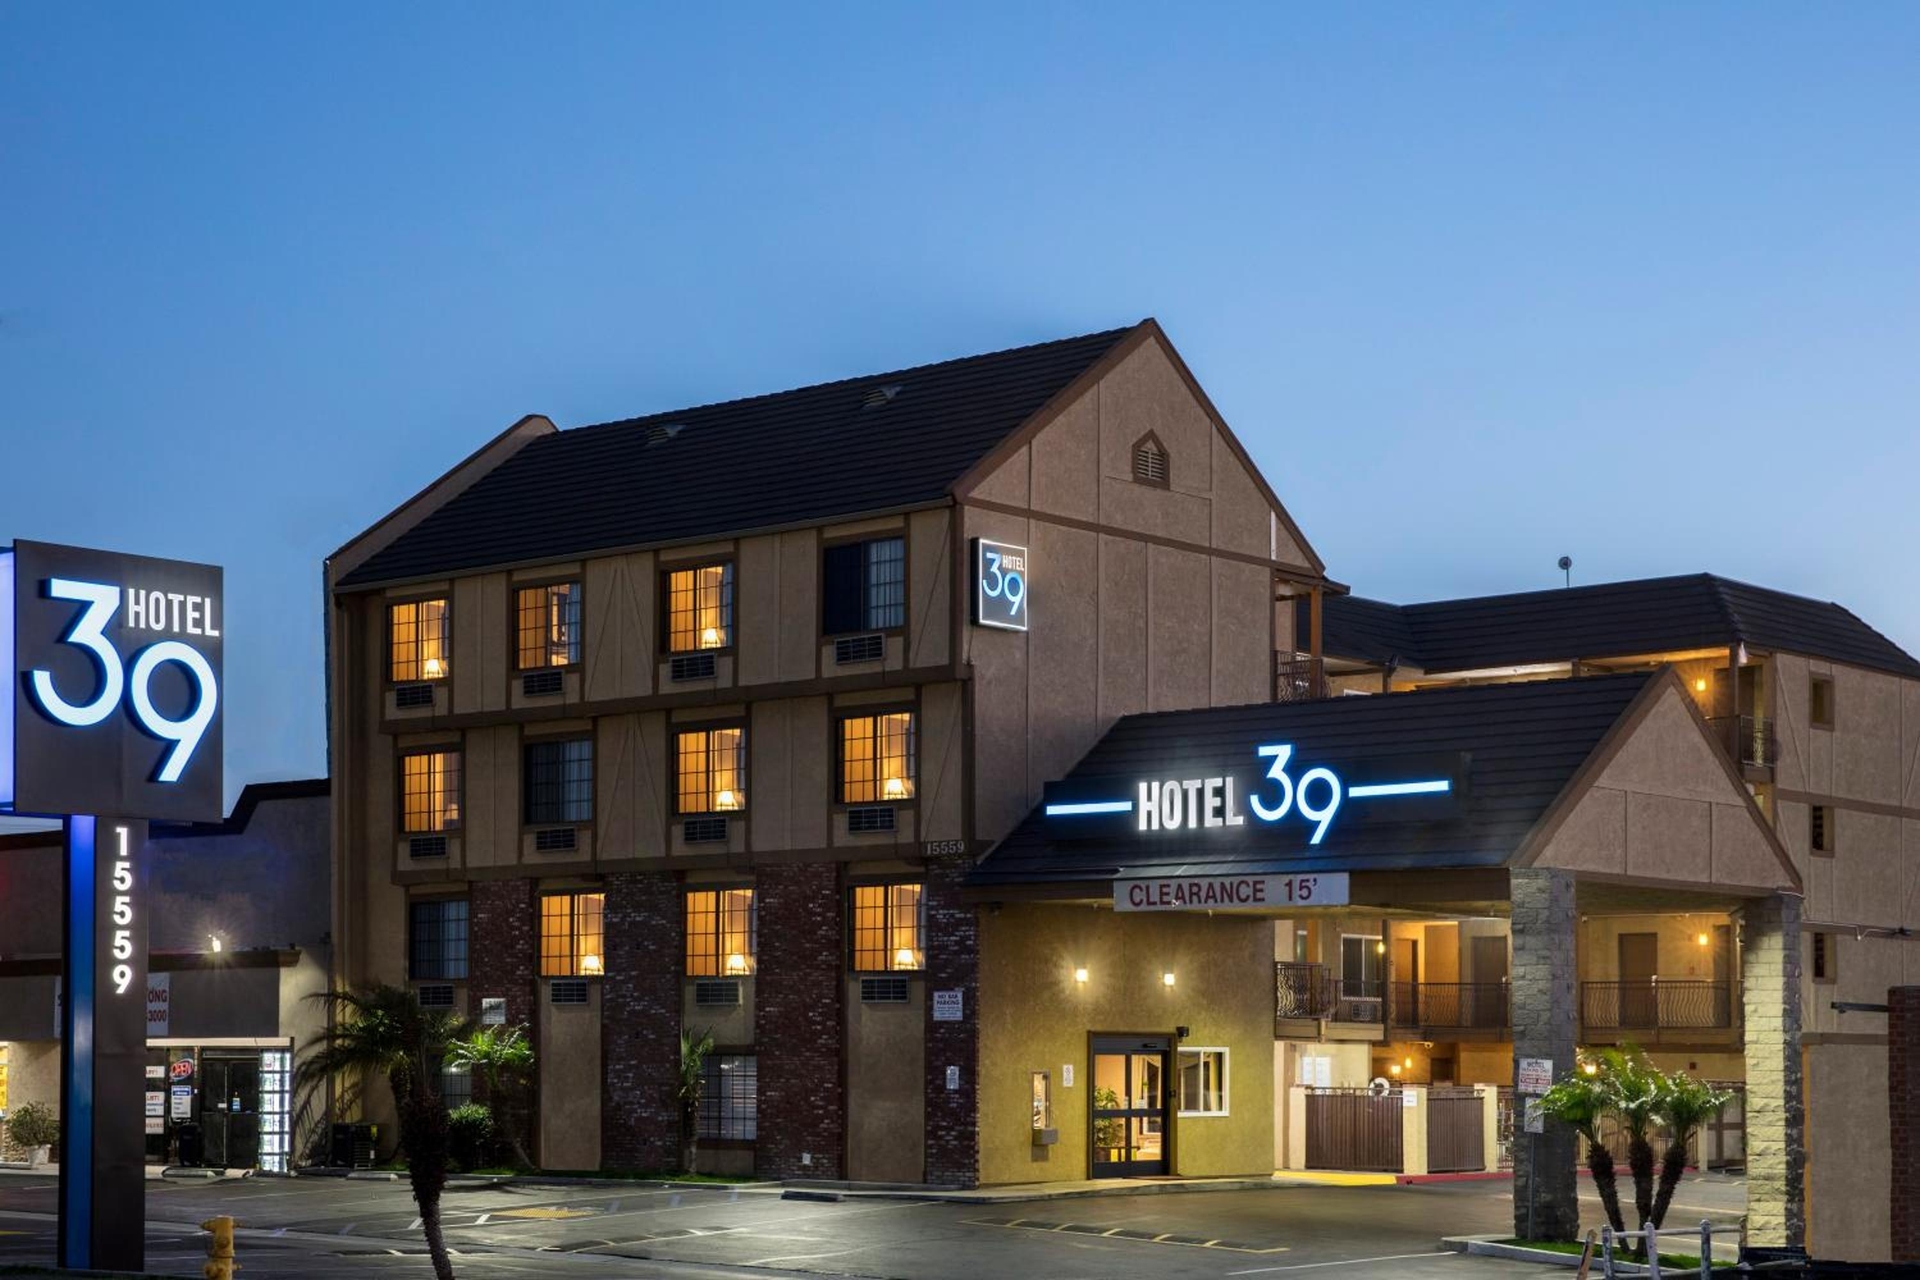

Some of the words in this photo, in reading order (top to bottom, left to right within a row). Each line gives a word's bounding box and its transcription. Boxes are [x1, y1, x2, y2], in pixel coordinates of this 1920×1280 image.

[983, 552, 1024, 615] 39
[1002, 555, 1024, 571] HOTEL
[128, 588, 219, 637] HOTEL
[32, 578, 217, 782] 39
[1138, 777, 1244, 830] HOTEL
[1250, 744, 1341, 844] 39
[927, 841, 964, 855] 15559
[113, 827, 132, 994] 15559
[1129, 880, 1265, 907] CLEARANCE
[1284, 878, 1318, 900] 15'
[171, 1061, 193, 1076] OPEN
